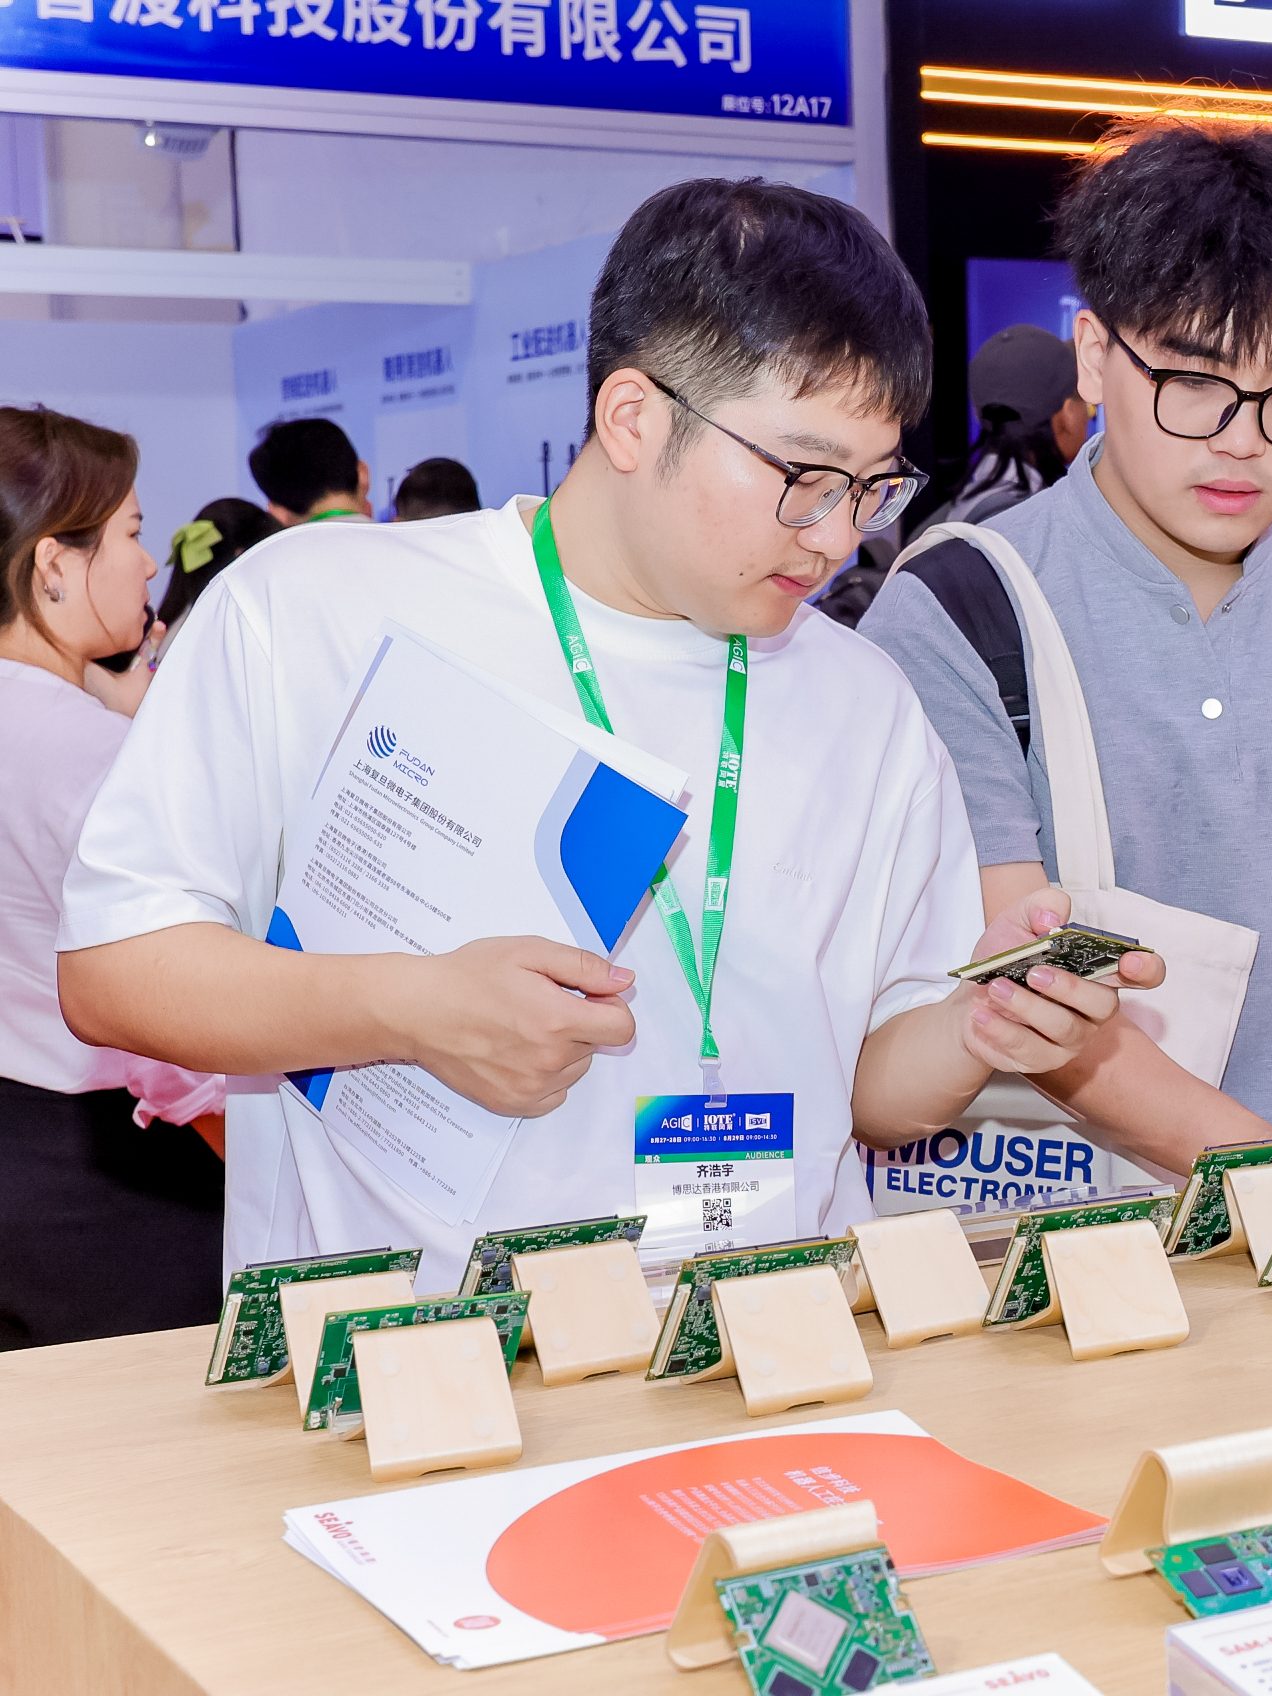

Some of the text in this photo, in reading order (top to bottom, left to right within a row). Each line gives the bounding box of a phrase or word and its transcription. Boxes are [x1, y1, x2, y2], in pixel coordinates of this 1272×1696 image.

[565, 635, 591, 673] AGIC
[730, 638, 747, 674] AGIC
[391, 759, 430, 788] MICRO
[397, 747, 437, 777] FUDAN
[725, 753, 741, 790] IOTE
[346, 769, 475, 858] Shanghai Fudan Microelectronics Group Company Limited
[351, 757, 484, 849] 上海复旦微电子集团股份有限公司
[661, 1114, 692, 1131] AGIC
[704, 1113, 734, 1124] IOTE
[644, 1150, 785, 1163] 观众 AUDIENCE
[696, 1163, 734, 1178] 齐浩宇
[887, 1128, 1094, 1184] MOUSER
[672, 1181, 760, 1195] 博思达香港有限公司
[886, 1167, 1070, 1201] ELECTRON
[313, 1511, 353, 1538] SEAVO
